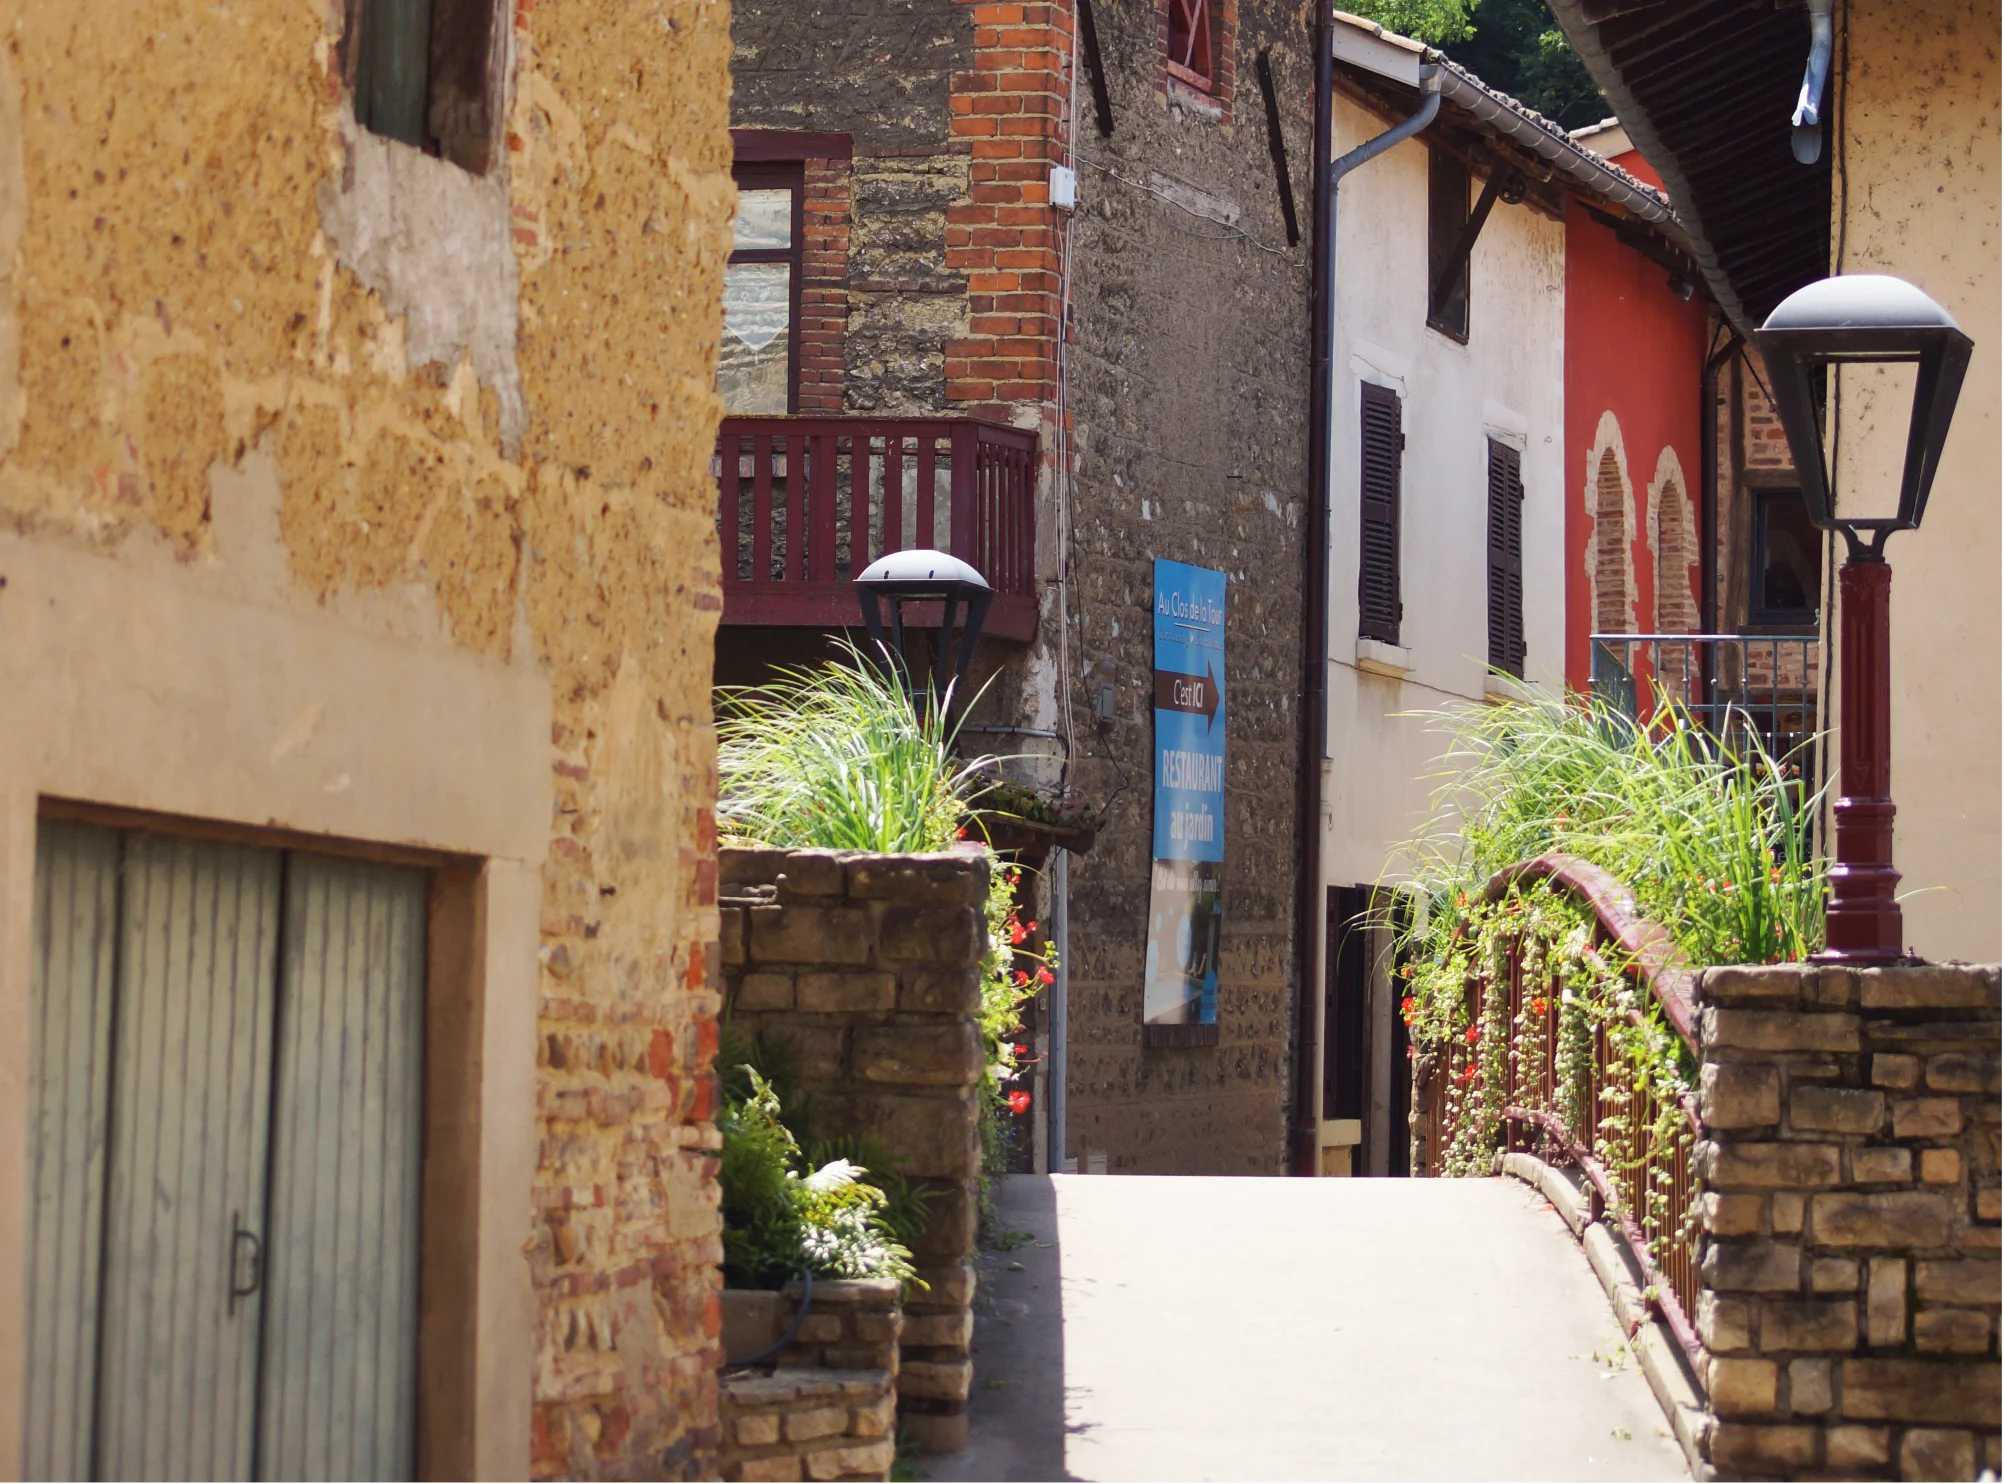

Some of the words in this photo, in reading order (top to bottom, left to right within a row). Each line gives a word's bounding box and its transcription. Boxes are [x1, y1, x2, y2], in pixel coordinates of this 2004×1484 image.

[1158, 589, 1169, 616] Au
[1171, 591, 1188, 619] Clos
[1190, 594, 1199, 621] de
[1200, 595, 1207, 623] la
[1207, 598, 1222, 626] Tour
[1173, 678, 1192, 706] C'est
[1192, 682, 1204, 708] ICI
[1162, 749, 1222, 792] RESTAURANT
[1170, 811, 1183, 840] au
[1183, 802, 1213, 850] jardin
